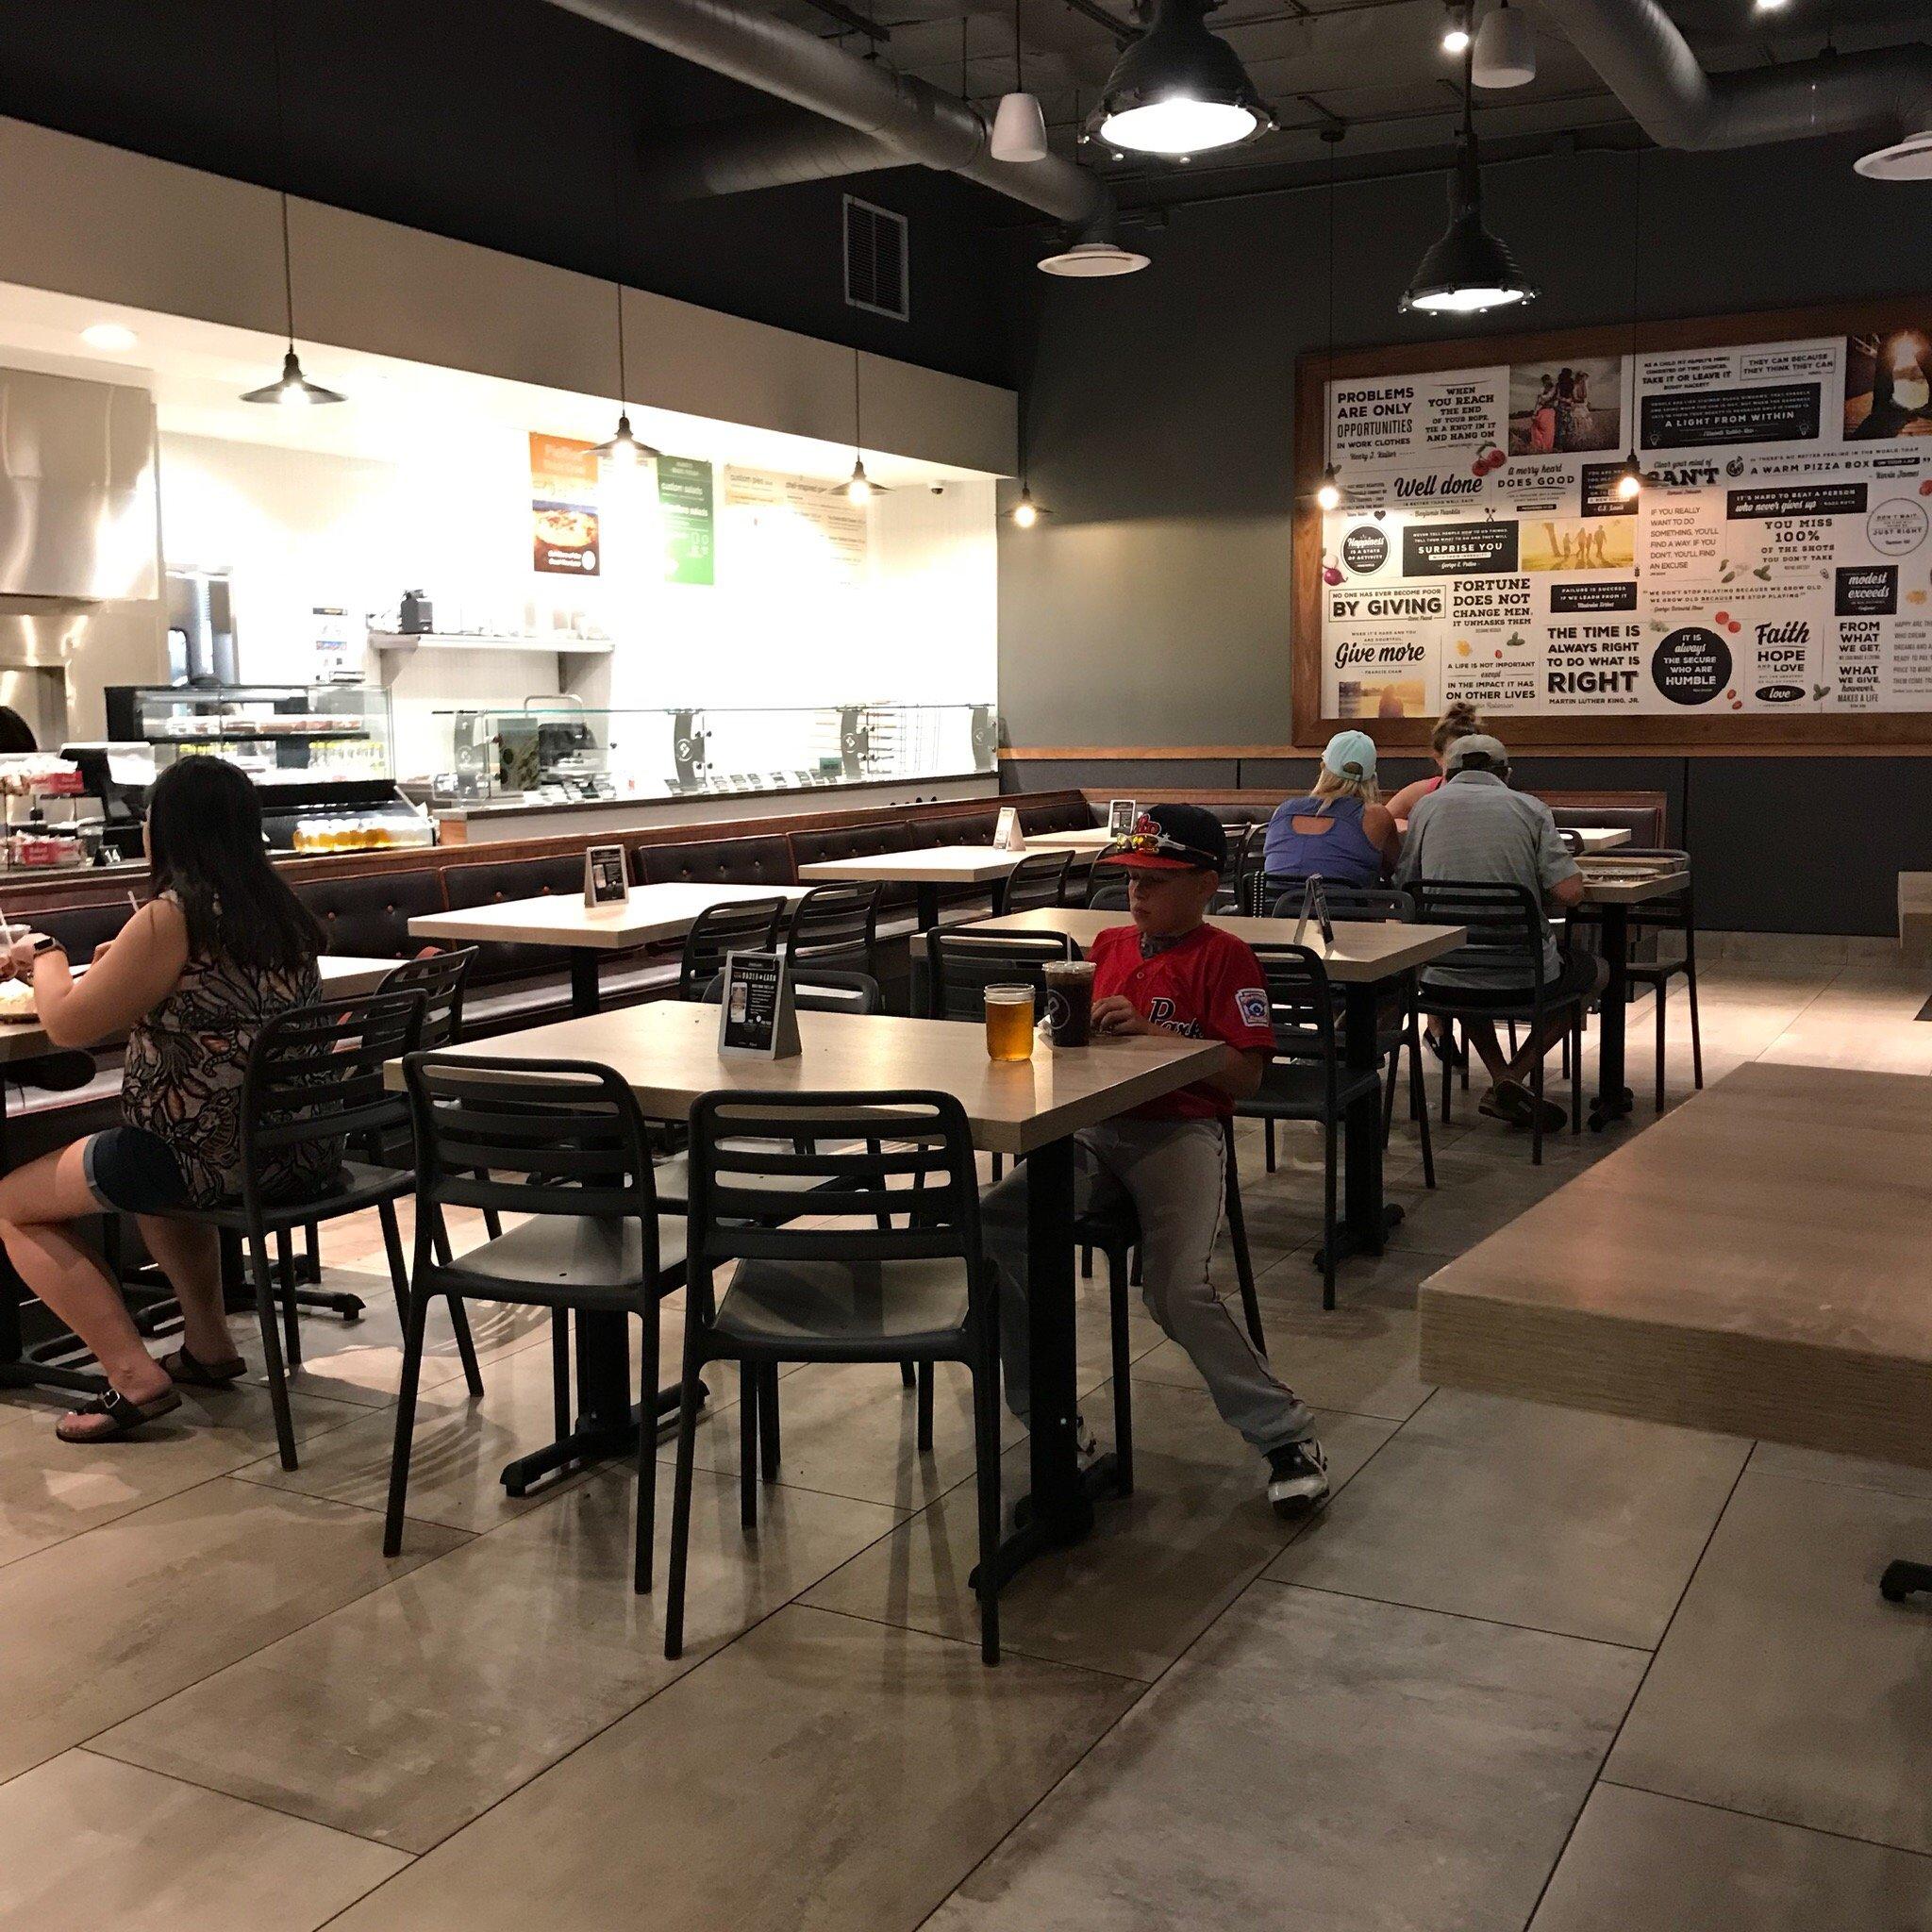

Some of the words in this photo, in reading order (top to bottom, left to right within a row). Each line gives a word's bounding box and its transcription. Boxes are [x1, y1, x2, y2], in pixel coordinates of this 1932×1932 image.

[1791, 353, 1827, 362] BECAUSE
[1692, 372, 1721, 380] LEAVE
[1338, 387, 1414, 404] PROBLEMS
[1446, 387, 1475, 395] WHEN
[1428, 398, 1452, 407] YOU
[1456, 394, 1494, 405] REACH
[1338, 406, 1368, 419] ARE
[1373, 403, 1412, 416] ONLY
[1462, 406, 1482, 414] END
[1676, 418, 1710, 426] LIGHT
[1715, 415, 1746, 425] FROM
[1751, 411, 1794, 422] WITHIN
[1338, 419, 1412, 438] OPPORTUNITIES
[1374, 438, 1410, 446] CLOTHES
[1426, 434, 1447, 442] AND
[1450, 432, 1478, 441] HANG
[1763, 464, 1799, 474] WARM
[1804, 463, 1840, 472] PIZZA
[1394, 475, 1437, 498] Well
[1441, 474, 1483, 494] done
[1498, 478, 1532, 488] DOES
[1538, 475, 1574, 485] GOOD
[1735, 504, 1753, 512] who
[1756, 502, 1779, 511] never
[1764, 521, 1792, 529] YOU
[1799, 519, 1833, 527] MISS
[1775, 530, 1820, 542] 100%
[1347, 537, 1385, 549] Happiness
[1418, 544, 1474, 555] SURPRISE
[1479, 542, 1503, 551] YOU
[1848, 572, 1888, 585] modest
[1453, 578, 1531, 592] FORTUNE
[1848, 585, 1890, 599] exceeds
[1453, 594, 1493, 607] DOES
[1498, 593, 1531, 605] NOT
[1333, 601, 1359, 617] BY
[1368, 597, 1442, 616] GIVING
[1453, 608, 1500, 618] CHANGE
[1547, 627, 1577, 639] THE
[1583, 626, 1620, 638] TIME
[1625, 625, 1641, 637] IS
[1840, 622, 1880, 631] FROM
[1755, 621, 1810, 645] Faith
[1840, 634, 1879, 643] WHAT
[1548, 643, 1597, 653] ALWAYS
[1602, 641, 1640, 653] RIGHT
[1674, 642, 1706, 656] always
[1335, 642, 1375, 669] Give
[1379, 643, 1425, 662] more
[1757, 650, 1806, 661] HOPE
[1547, 658, 1563, 667] TO
[1567, 658, 1585, 666] DO
[1589, 657, 1624, 666] WHAT
[1628, 657, 1641, 665] IS
[1840, 666, 1879, 675] WHAT
[1547, 671, 1640, 694] RIGHT
[1666, 675, 1717, 686] HUMBLE
[1445, 691, 1462, 700] ON
[1466, 691, 1501, 700] OTHER
[1505, 691, 1536, 699] LIVES
[1769, 688, 1790, 698] love
